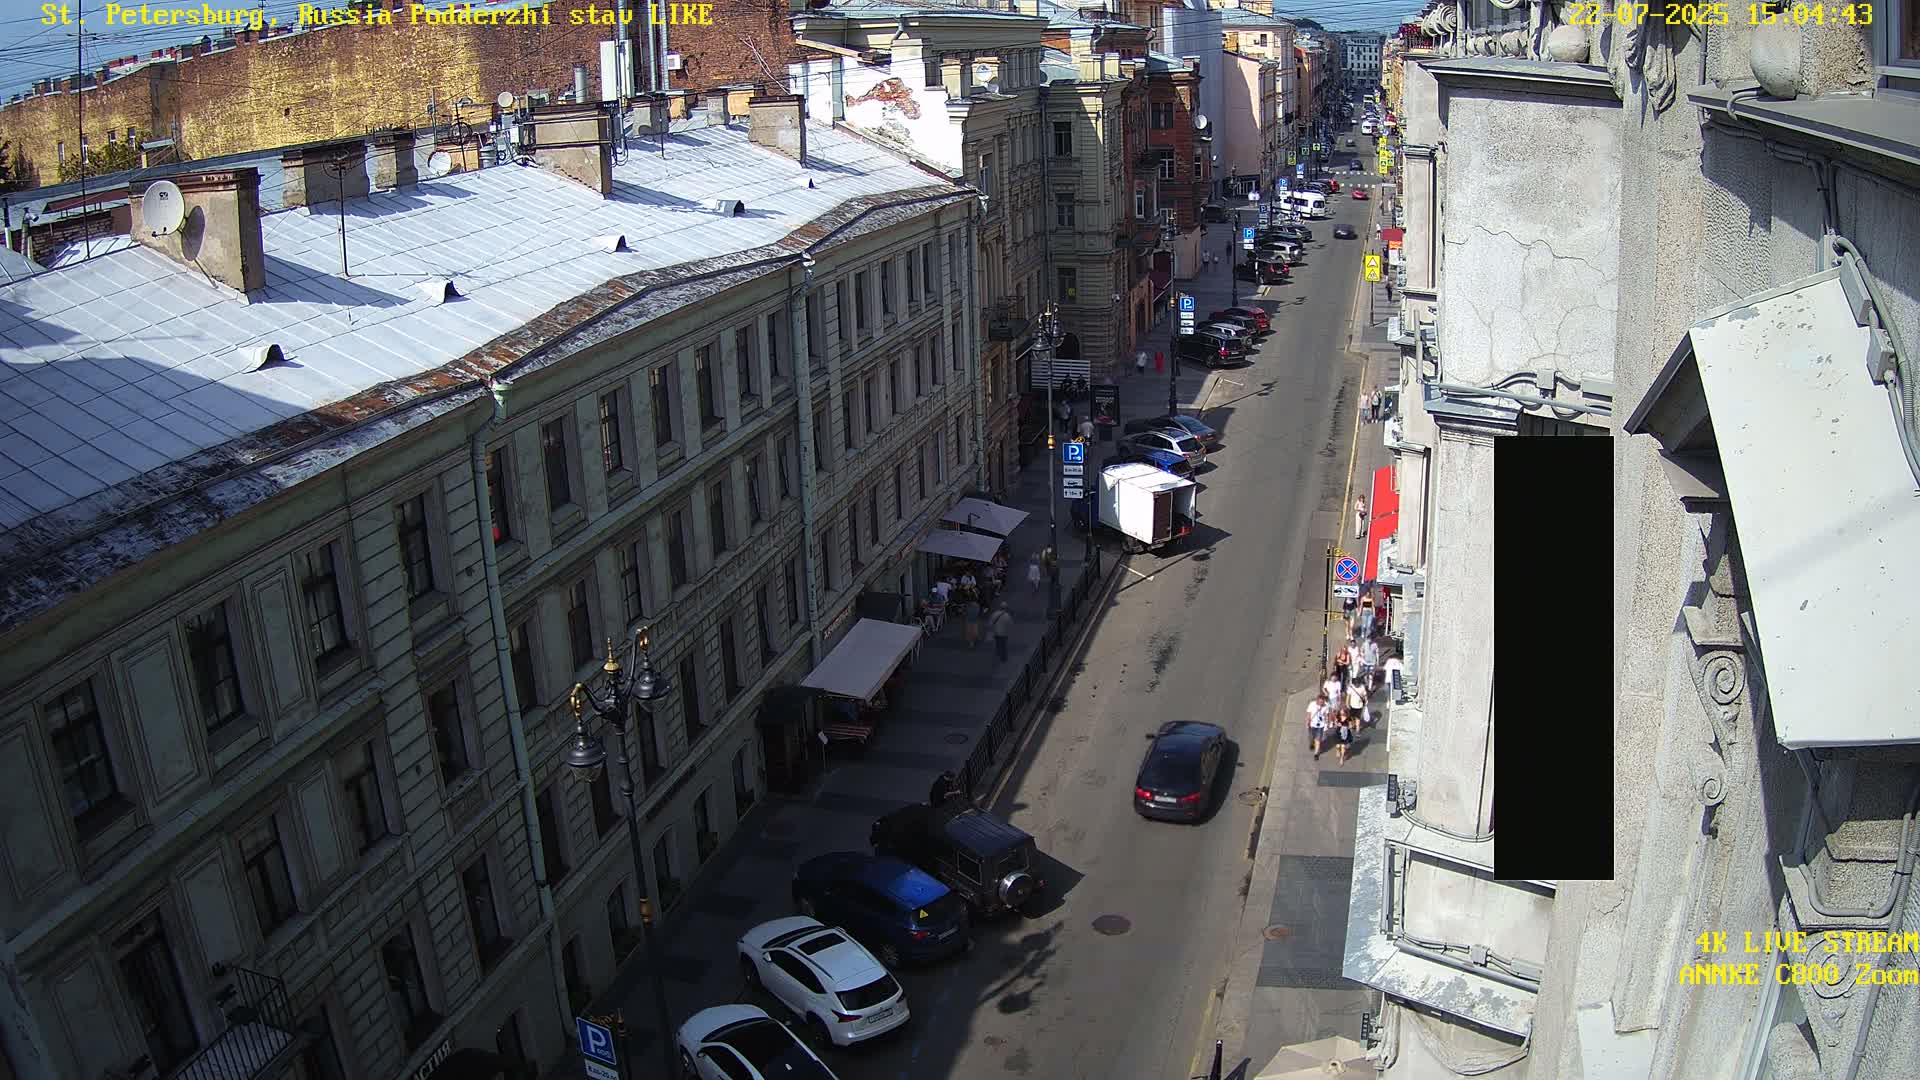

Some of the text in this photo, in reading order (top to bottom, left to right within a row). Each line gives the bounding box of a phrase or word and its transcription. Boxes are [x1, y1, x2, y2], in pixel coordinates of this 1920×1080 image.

[1183, 298, 1191, 309] P
[1068, 445, 1080, 461] P
[586, 1025, 607, 1054] P
